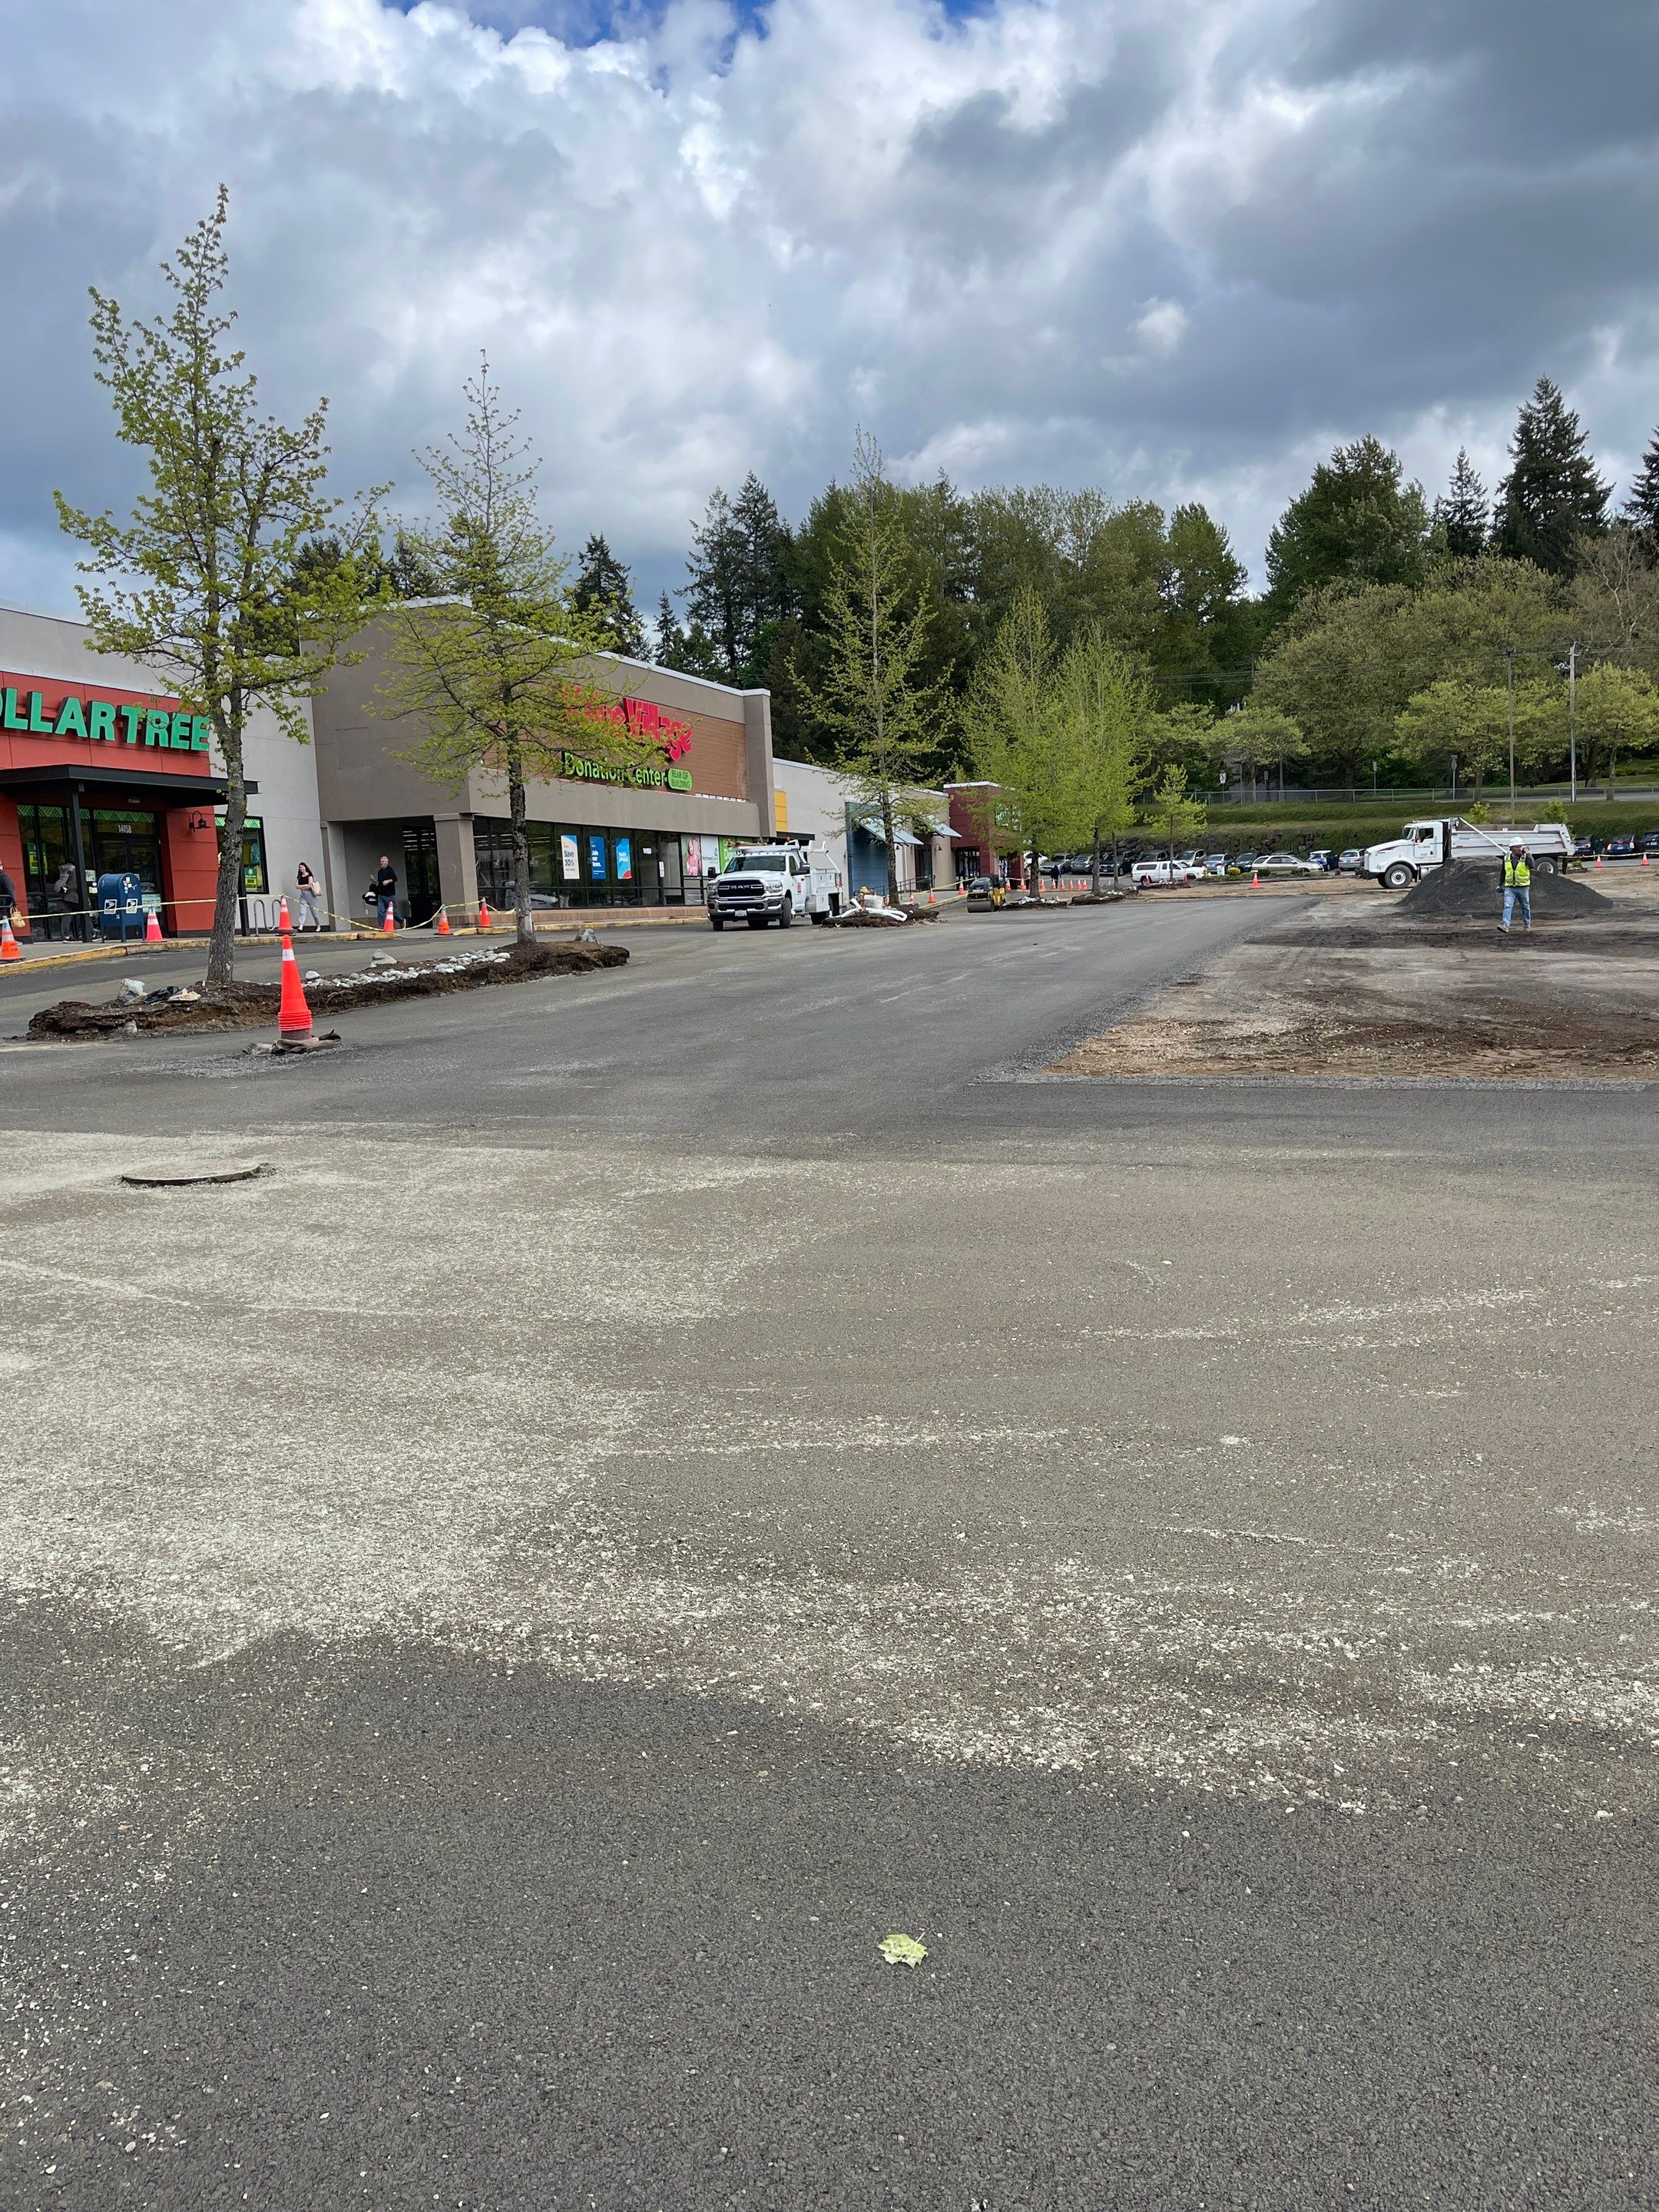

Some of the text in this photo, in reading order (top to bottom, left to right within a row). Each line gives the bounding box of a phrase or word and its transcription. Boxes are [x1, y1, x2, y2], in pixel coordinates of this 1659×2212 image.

[0, 687, 210, 752] LLAR TREE
[671, 770, 689, 780] REAR OF
[671, 779, 690, 789] BUILDING
